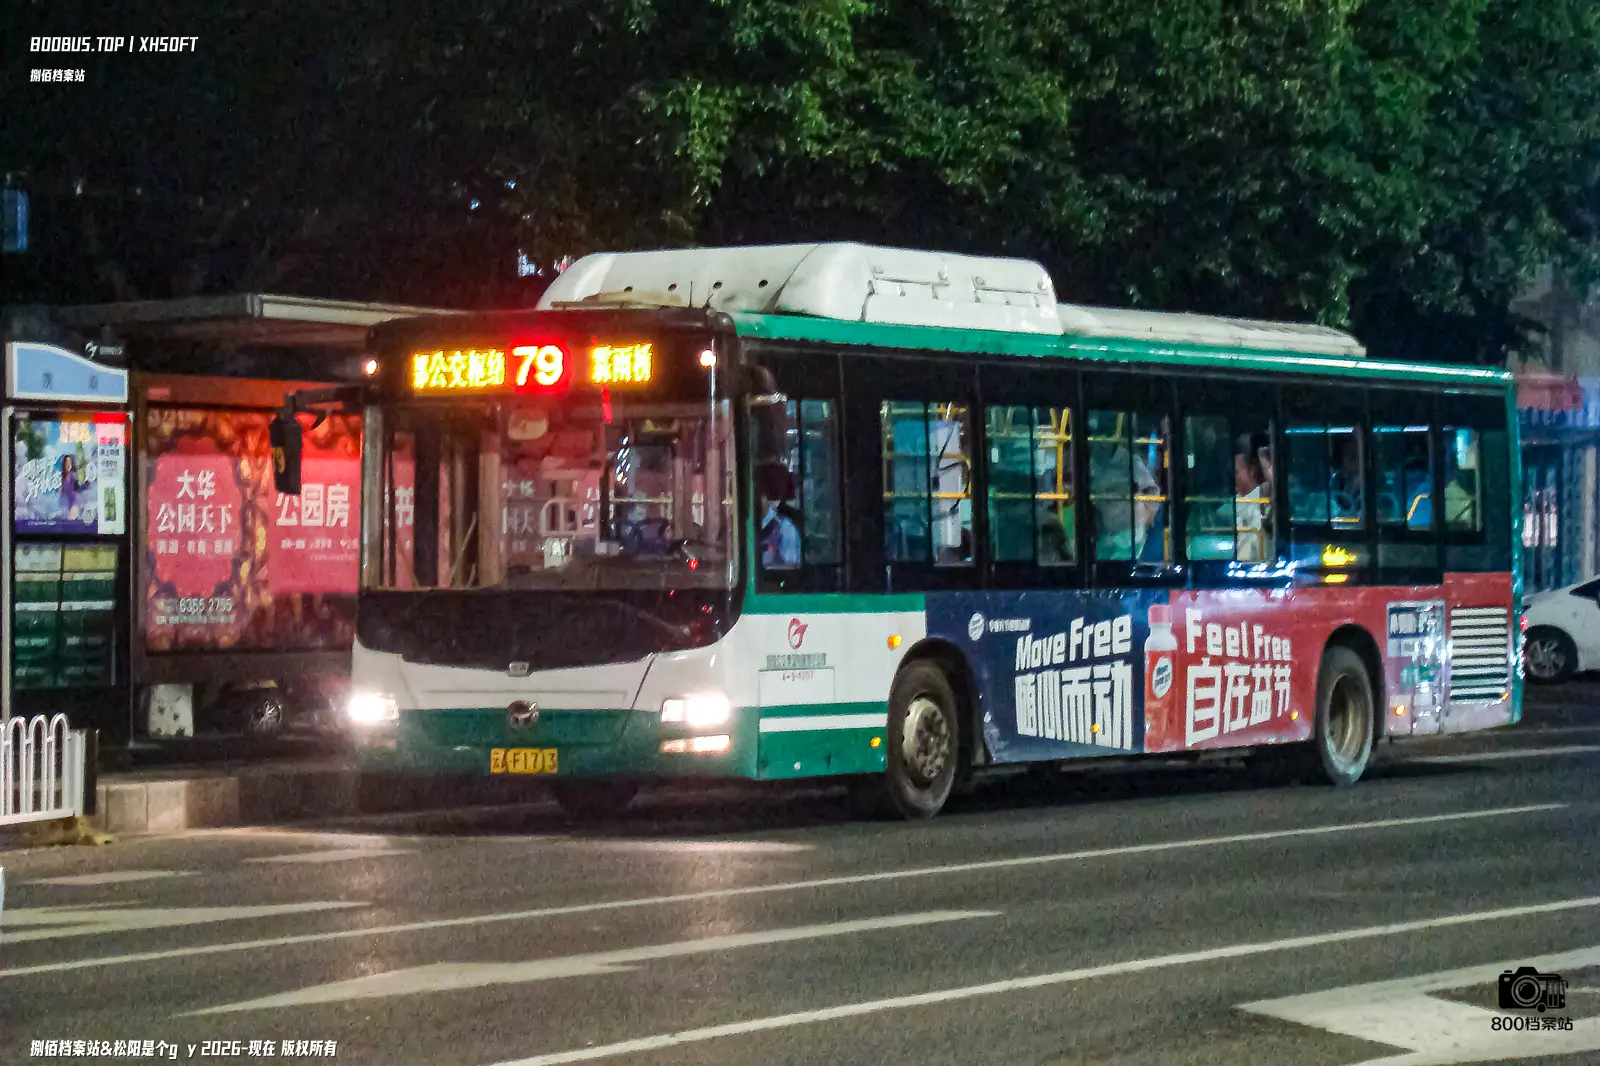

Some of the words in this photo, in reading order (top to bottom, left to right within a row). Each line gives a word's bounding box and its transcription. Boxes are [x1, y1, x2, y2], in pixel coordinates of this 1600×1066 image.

[512, 345, 564, 386] 79
[176, 469, 216, 500] 大华
[275, 483, 350, 527] 公园房
[155, 503, 233, 534] 公园天下
[1015, 632, 1067, 671] Move
[1069, 613, 1132, 662] Free
[1185, 607, 1249, 659] Feel
[1252, 624, 1291, 661] Free
[1184, 657, 1291, 748] 自在益节
